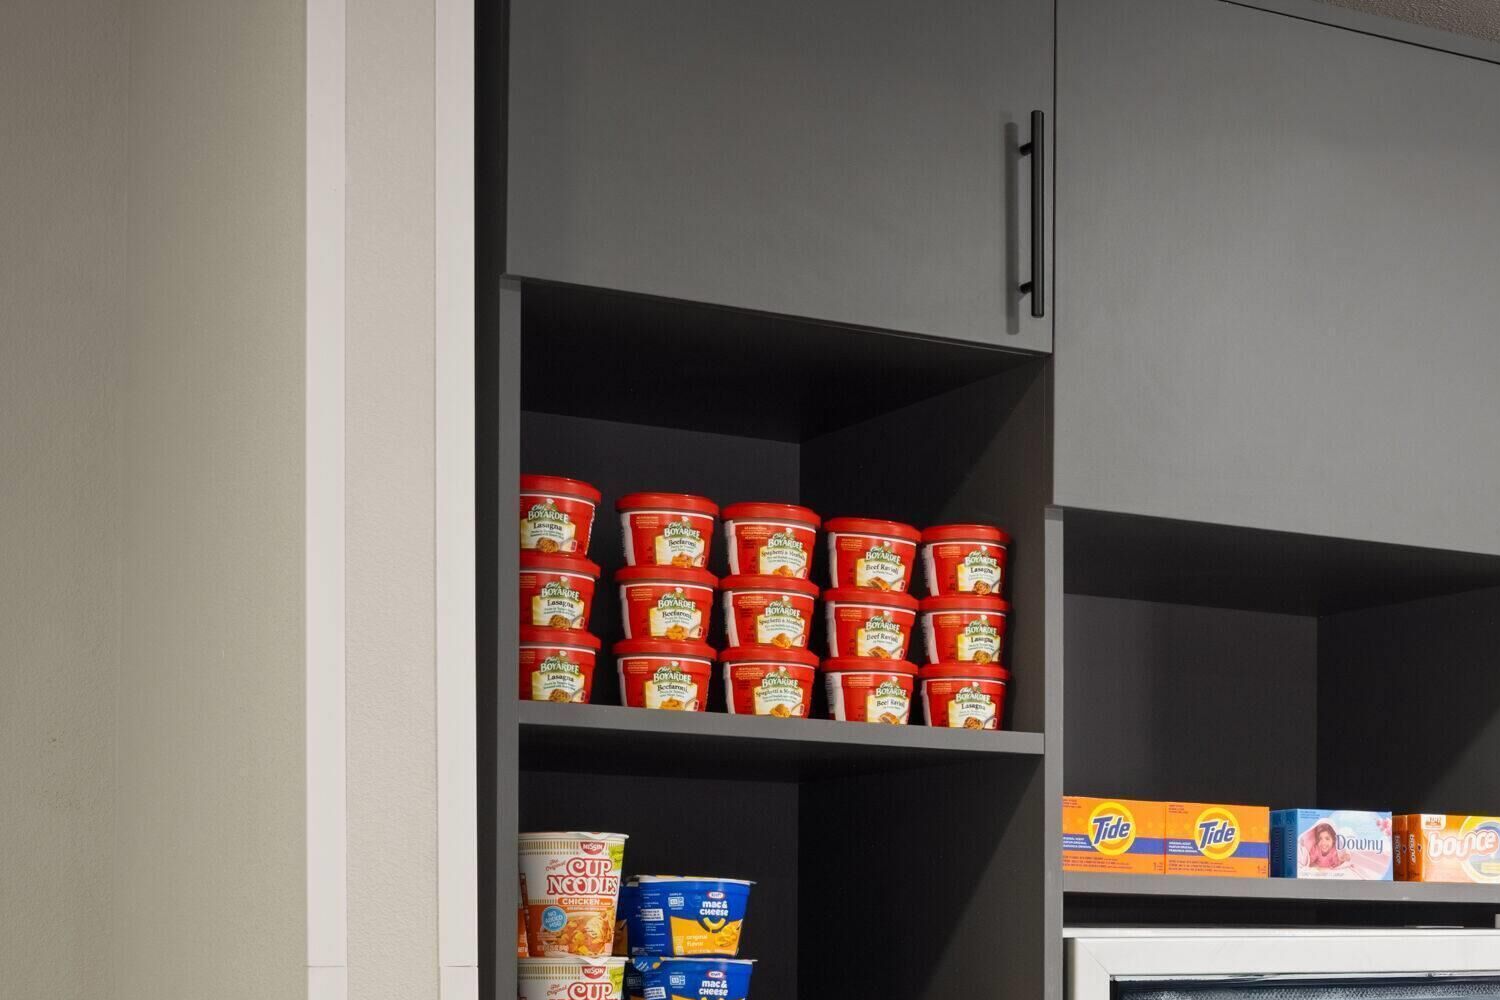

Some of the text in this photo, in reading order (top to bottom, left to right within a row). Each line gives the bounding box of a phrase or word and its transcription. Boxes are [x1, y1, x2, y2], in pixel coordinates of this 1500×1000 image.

[528, 510, 569, 523] BOYARDEE
[533, 522, 562, 531] Lasagna
[664, 528, 701, 539] BOYARDEE
[768, 538, 803, 549] BOYARDEE
[866, 552, 901, 564] BOYARDEE
[964, 557, 998, 568] BOYARDEE
[541, 587, 580, 601] BOYARDEE
[547, 600, 574, 609] Lasagna
[658, 600, 696, 610] BOYARDEE
[765, 607, 801, 618] BOYARDEE
[866, 622, 900, 634] BOYARDEE
[965, 626, 997, 636] BOYARDEE
[540, 663, 580, 675] BOYARDEE
[547, 674, 574, 682] Lasagna
[653, 673, 692, 684] BOYARDEE
[761, 677, 799, 688] BOYARDEE
[875, 688, 907, 699] BOYARDEE
[955, 692, 992, 704] BOYARDEE
[961, 703, 986, 711] Lasagna
[1090, 814, 1132, 846] Tide
[1197, 818, 1237, 850] Tide
[1336, 834, 1384, 854] Downy
[1428, 830, 1499, 859] bounce
[566, 857, 612, 877] CUP
[547, 874, 618, 895] NOODLES
[567, 981, 613, 1000] CUP
